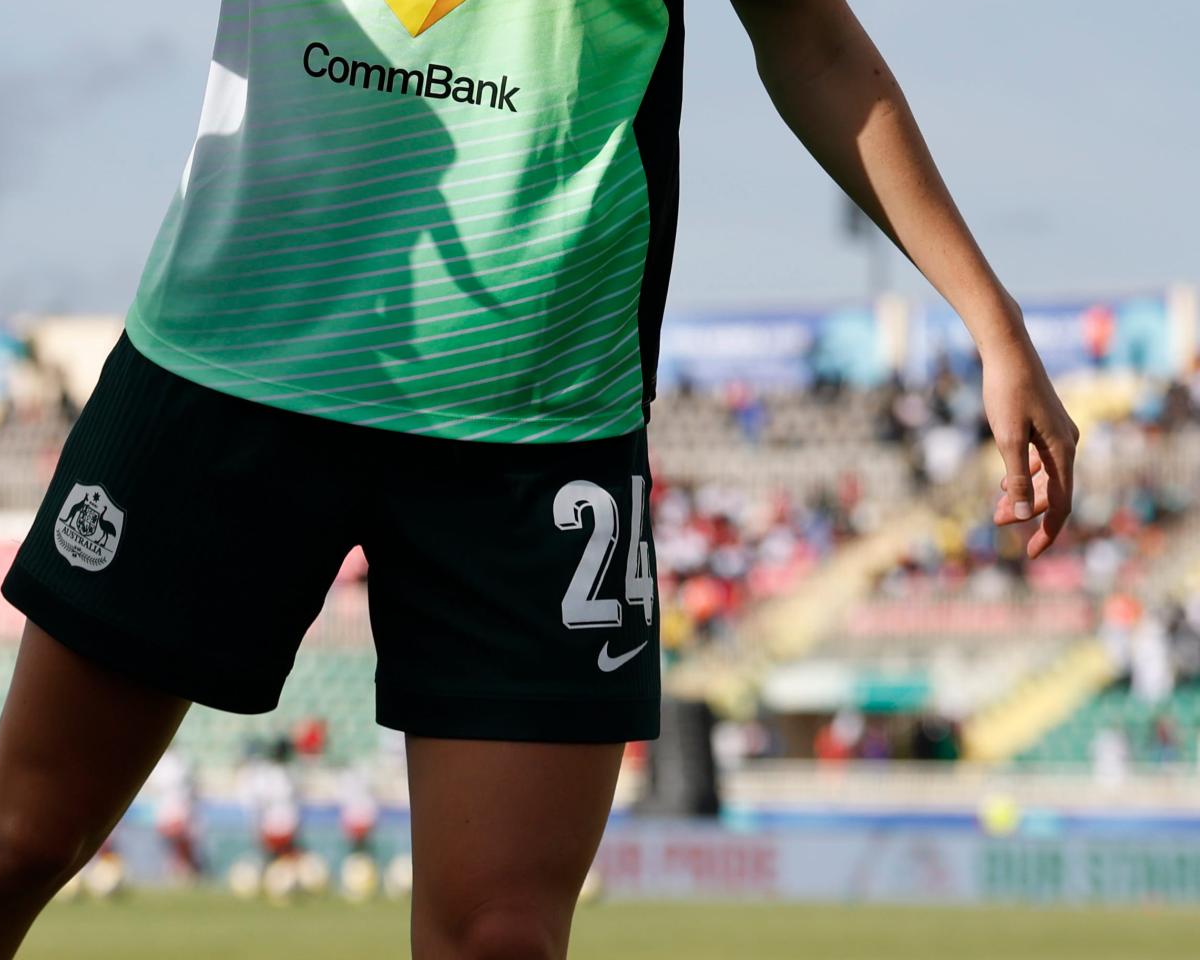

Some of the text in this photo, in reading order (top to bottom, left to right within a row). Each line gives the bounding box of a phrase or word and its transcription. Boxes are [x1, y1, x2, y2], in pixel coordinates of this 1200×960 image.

[303, 41, 521, 112] CommBank
[62, 526, 103, 557] AUSTRALIA
[552, 475, 654, 630] 24
